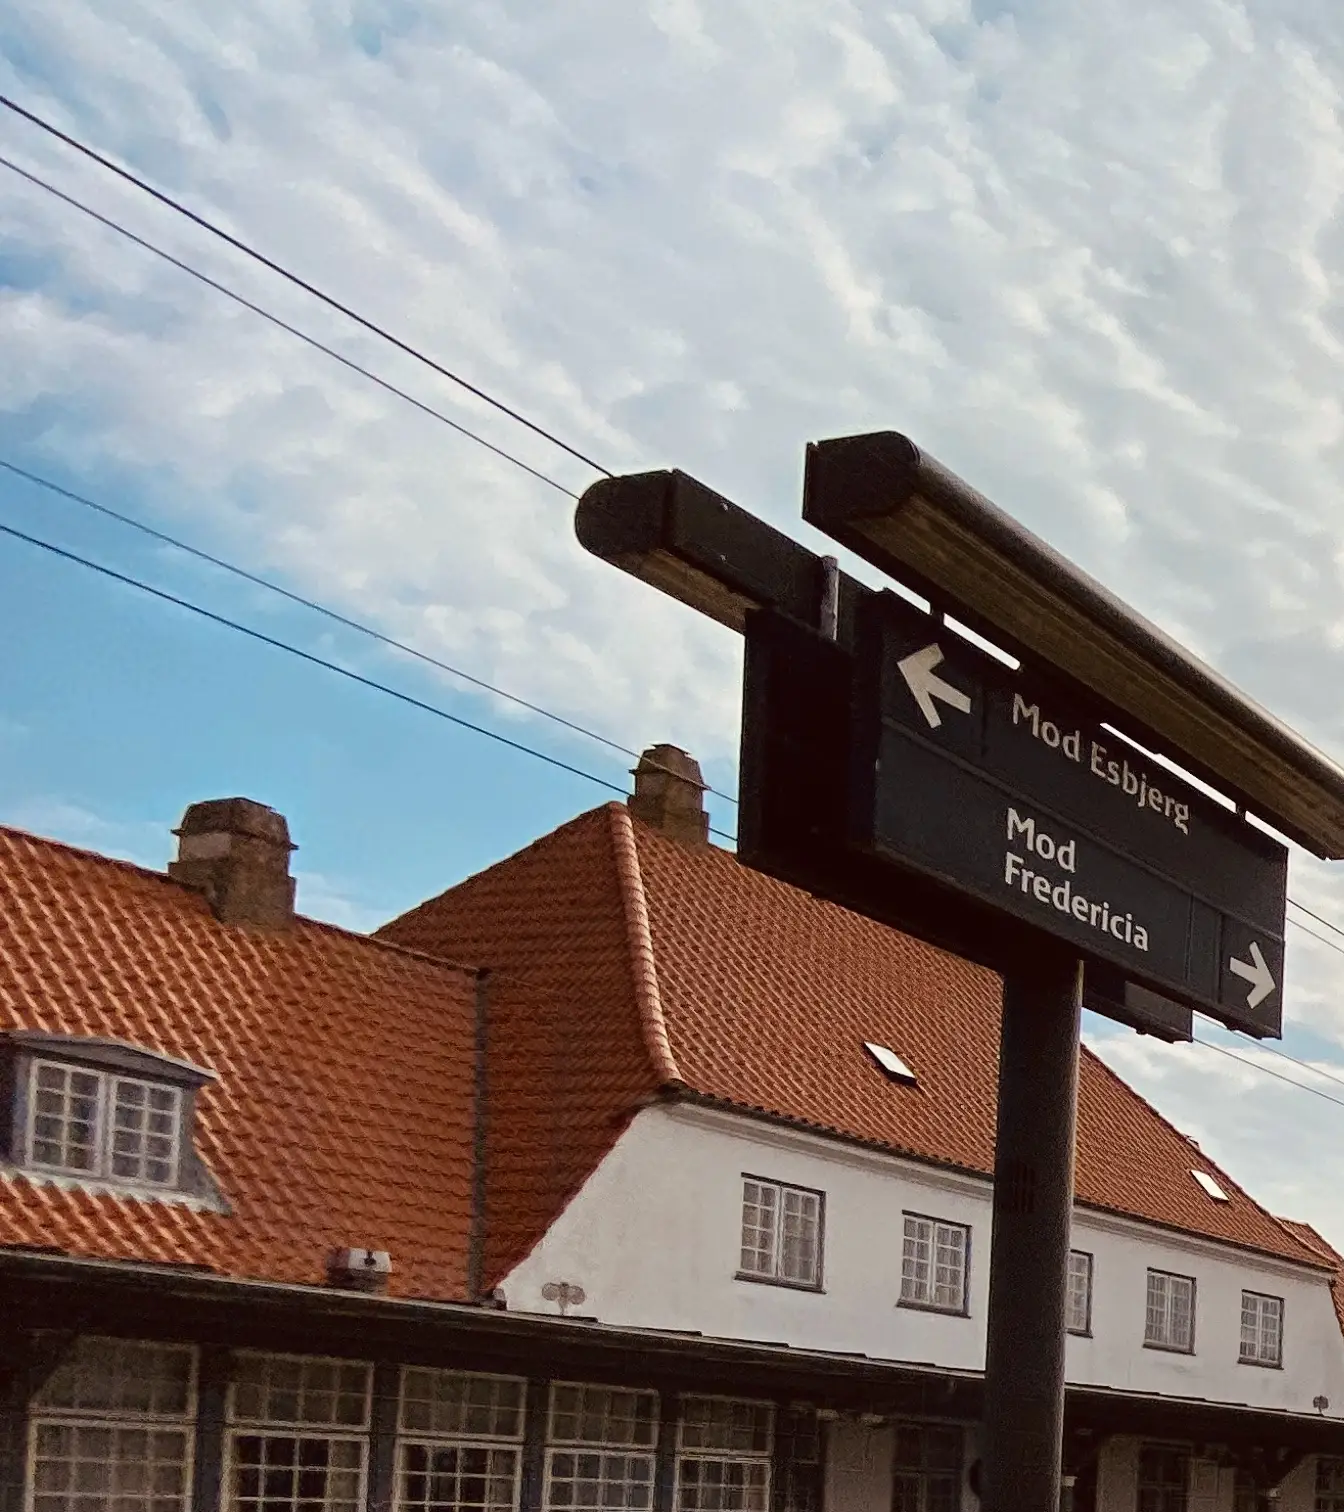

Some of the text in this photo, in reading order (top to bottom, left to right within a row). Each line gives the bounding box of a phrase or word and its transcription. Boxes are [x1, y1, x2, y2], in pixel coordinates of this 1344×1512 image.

[1012, 692, 1190, 836] Mod Esbjerg
[1006, 807, 1076, 874] Mod
[1005, 851, 1149, 952] Fredericia
